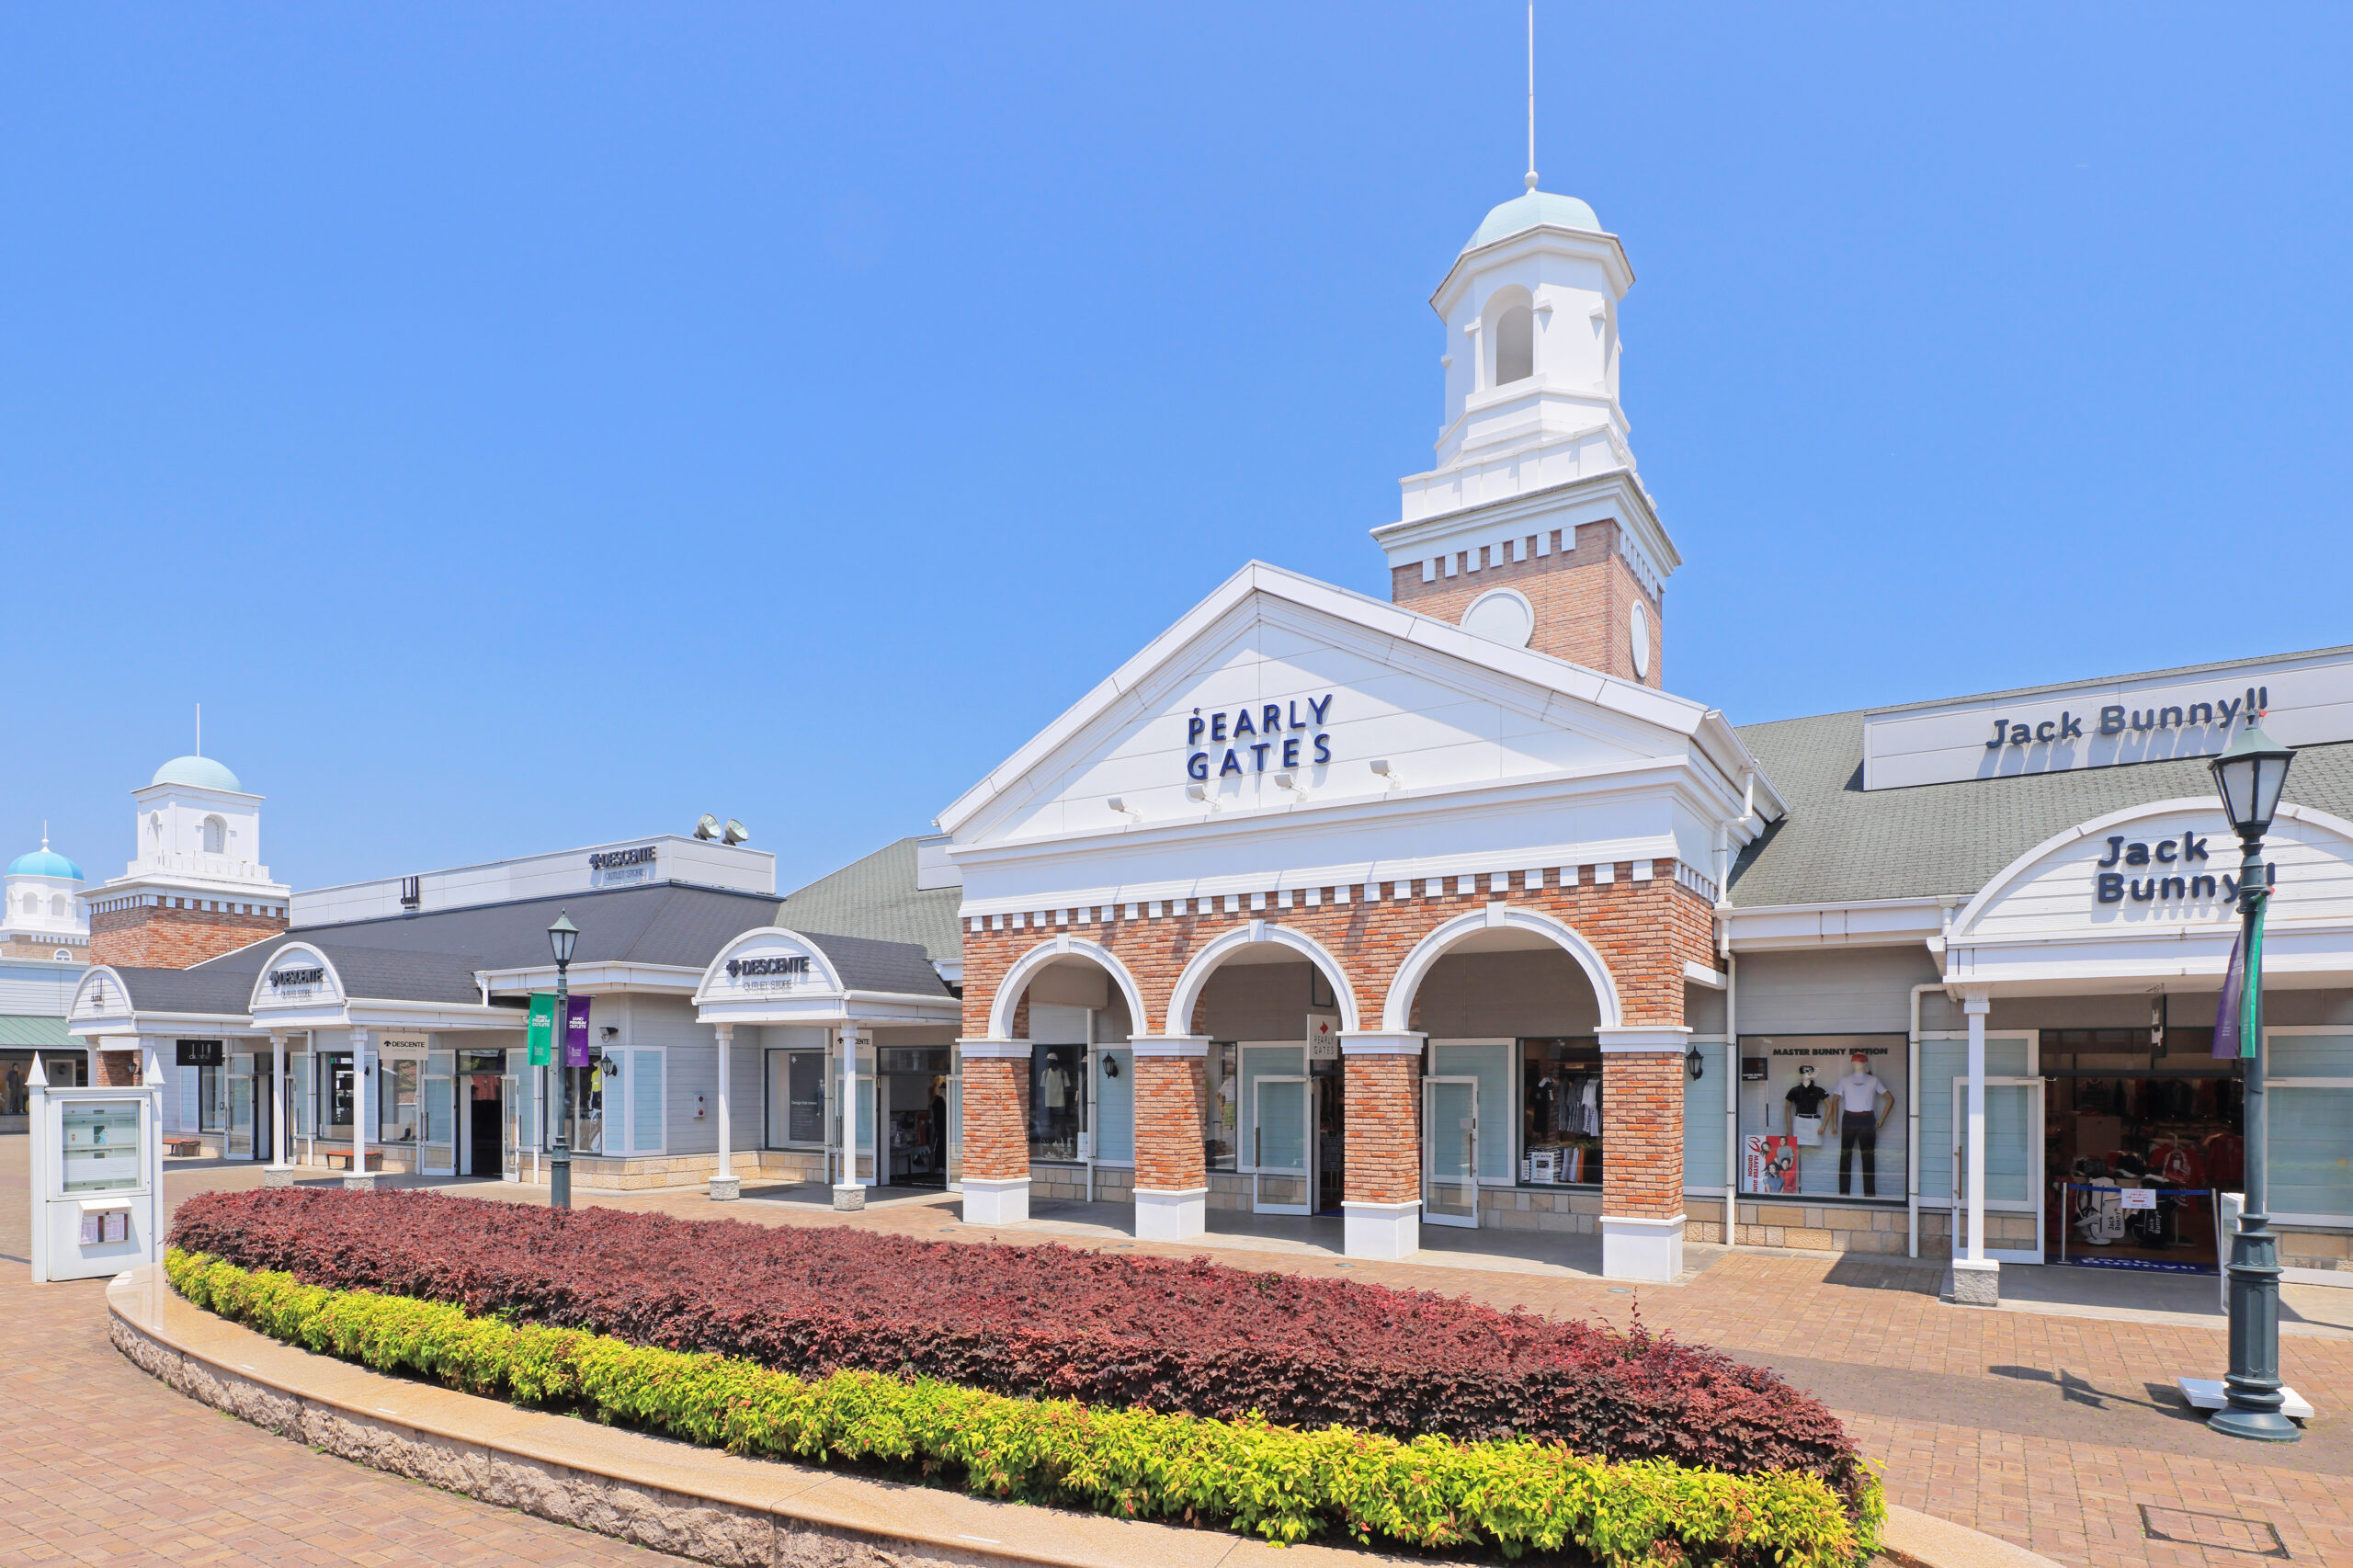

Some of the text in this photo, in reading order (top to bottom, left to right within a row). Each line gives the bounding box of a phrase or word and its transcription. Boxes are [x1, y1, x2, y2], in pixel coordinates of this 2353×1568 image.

[1188, 694, 1332, 745] PEARLY
[1985, 686, 2268, 749] Jack Bunny!!
[1187, 733, 1331, 780] GATES
[602, 846, 656, 868] DESCENTE
[2097, 831, 2209, 868] Jack
[2097, 862, 2276, 904] Bunny!
[279, 968, 324, 985] DESCENTE
[743, 956, 809, 976] DESCENTE
[743, 979, 792, 991] OUTLET STORE
[1314, 1036, 1334, 1044] PEARLY
[1314, 1046, 1334, 1054] GATES
